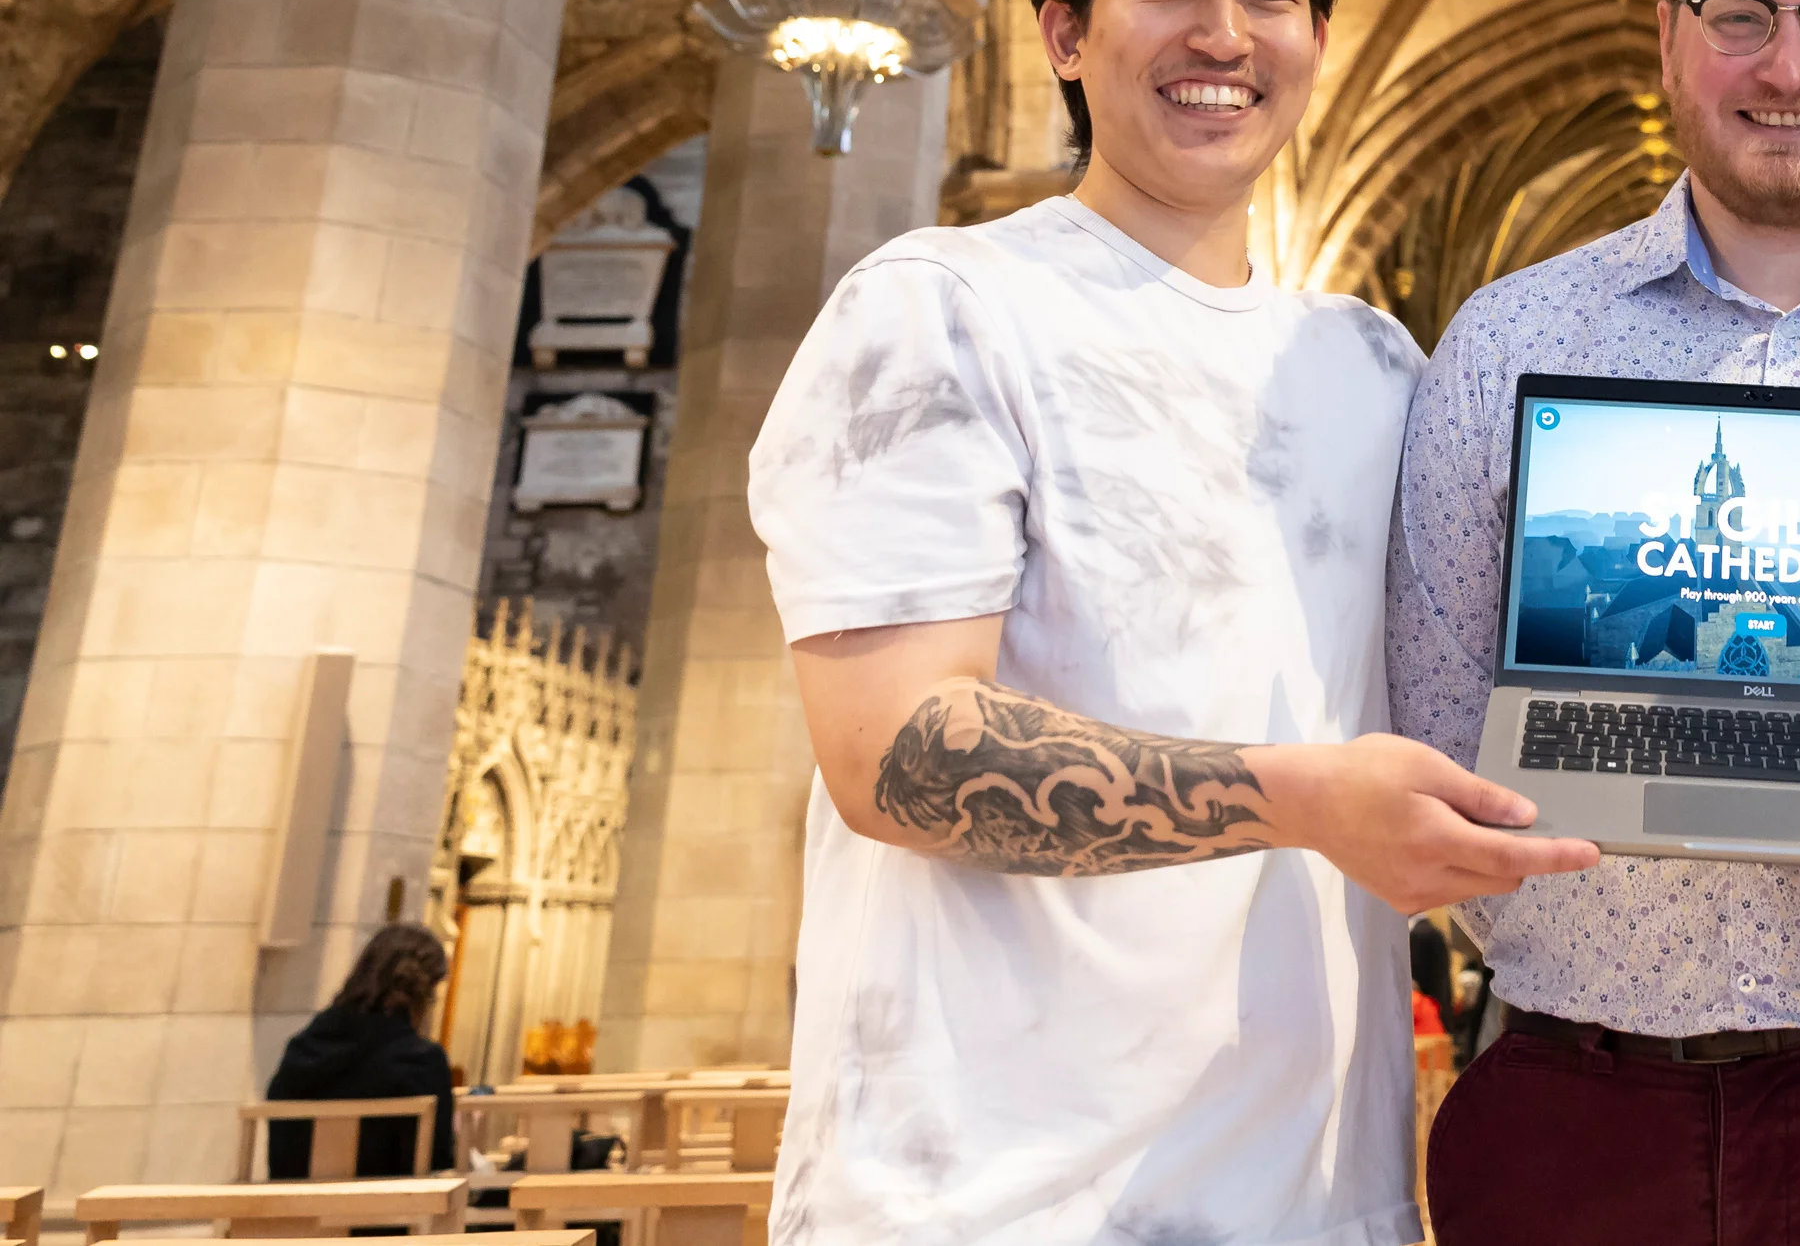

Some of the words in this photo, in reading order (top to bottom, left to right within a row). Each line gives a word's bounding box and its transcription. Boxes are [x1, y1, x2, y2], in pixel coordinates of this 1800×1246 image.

[1638, 491, 1702, 540] ST
[1680, 587, 1702, 603] Play
[1704, 588, 1742, 604] through
[1744, 591, 1767, 603] 900
[1768, 594, 1797, 606] years
[1747, 619, 1776, 631] START
[1743, 685, 1775, 697] DELL
